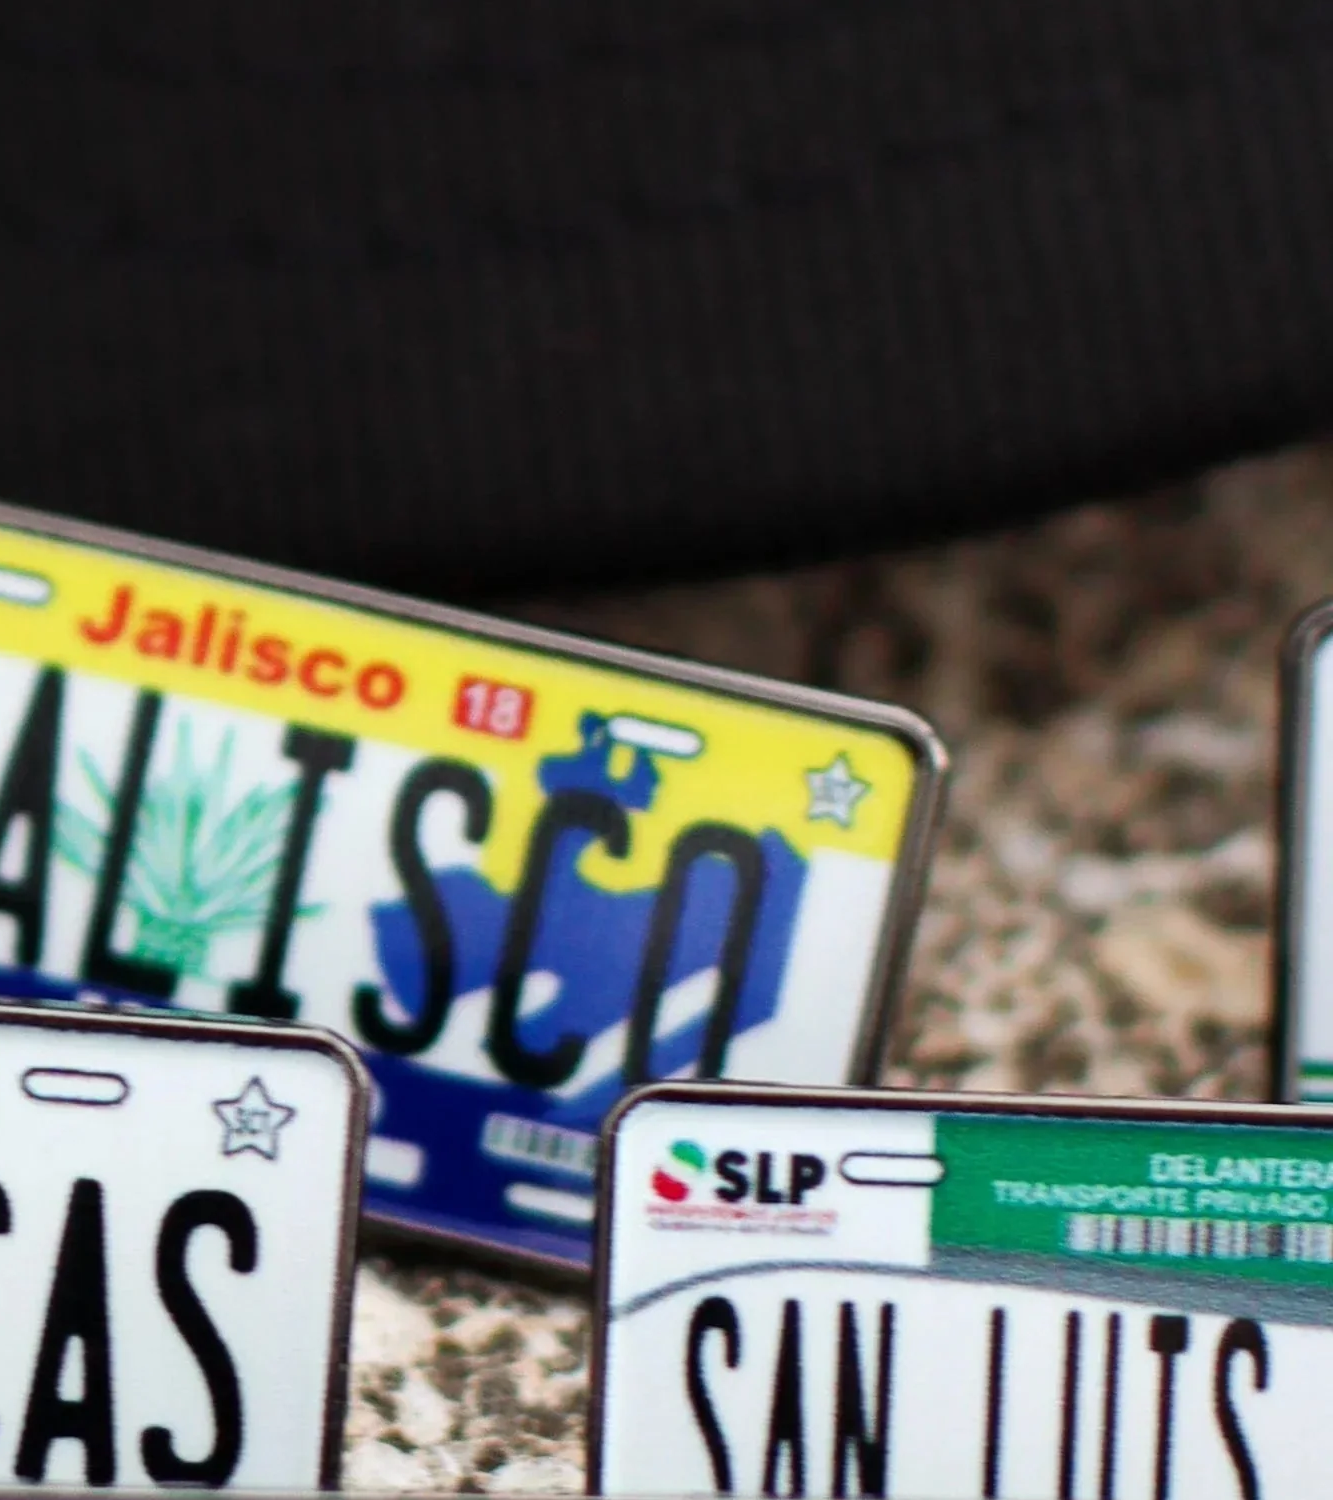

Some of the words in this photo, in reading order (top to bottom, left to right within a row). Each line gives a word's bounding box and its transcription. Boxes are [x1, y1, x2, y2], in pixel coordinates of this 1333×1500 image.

[79, 584, 408, 713] Jalisco
[464, 681, 531, 734] 18
[712, 1148, 827, 1206] SLP
[990, 1178, 1190, 1213] TRANSPORTE
[684, 1295, 897, 1500] SAN
